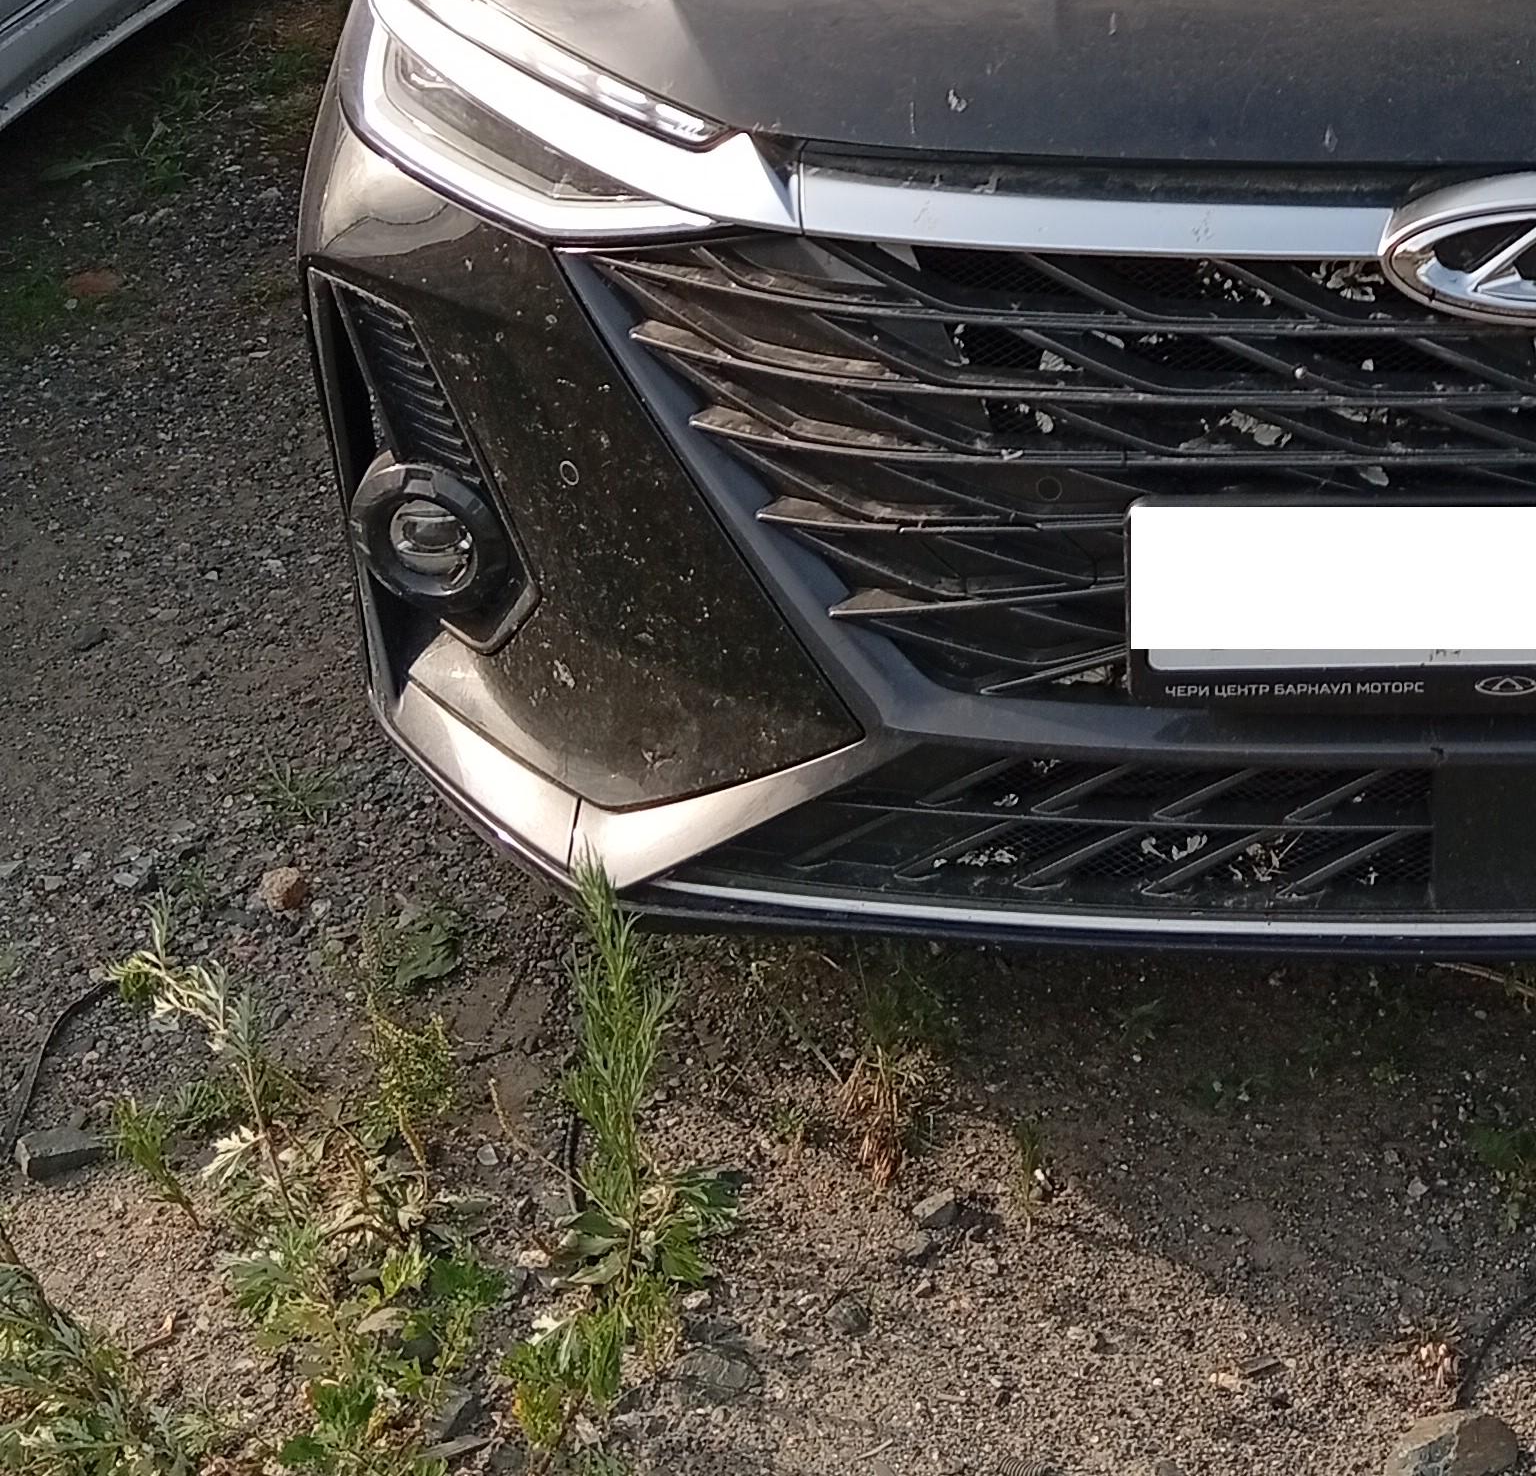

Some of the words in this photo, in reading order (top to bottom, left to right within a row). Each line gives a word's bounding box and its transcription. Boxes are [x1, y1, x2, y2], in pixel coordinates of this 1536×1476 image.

[1165, 685, 1210, 697] ЧЕРИ
[1214, 684, 1270, 698] ЦЕНТР
[1274, 682, 1352, 696] БАРНАУЛ
[1356, 681, 1425, 695] МОТОРС
